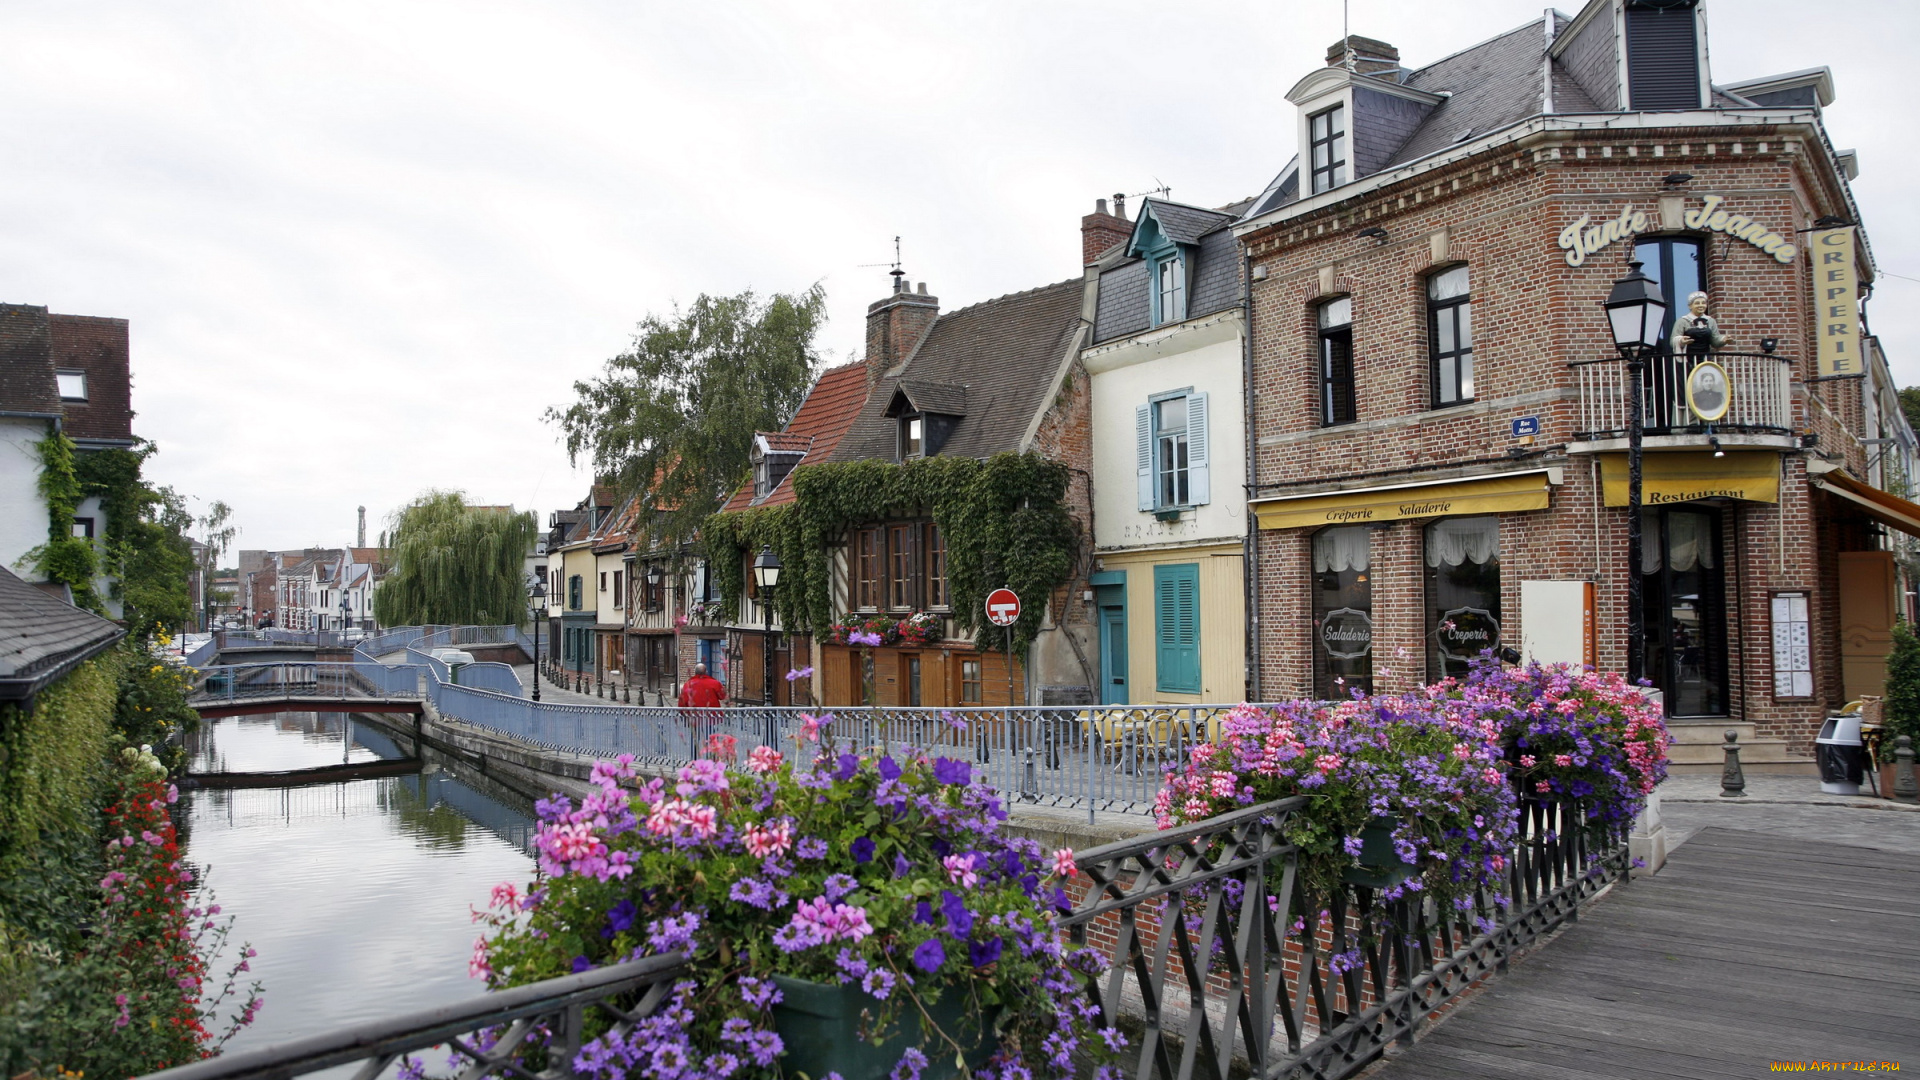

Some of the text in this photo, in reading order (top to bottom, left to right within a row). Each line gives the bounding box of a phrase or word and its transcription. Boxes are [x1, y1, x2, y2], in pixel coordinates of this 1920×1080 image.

[1558, 195, 1797, 267] Tante Jeanne
[1821, 232, 1850, 372] CREPERIE
[1648, 489, 1745, 504] Restaurant
[1326, 501, 1451, 522] Crêperie Saladerie
[1324, 625, 1370, 642] Saladerie
